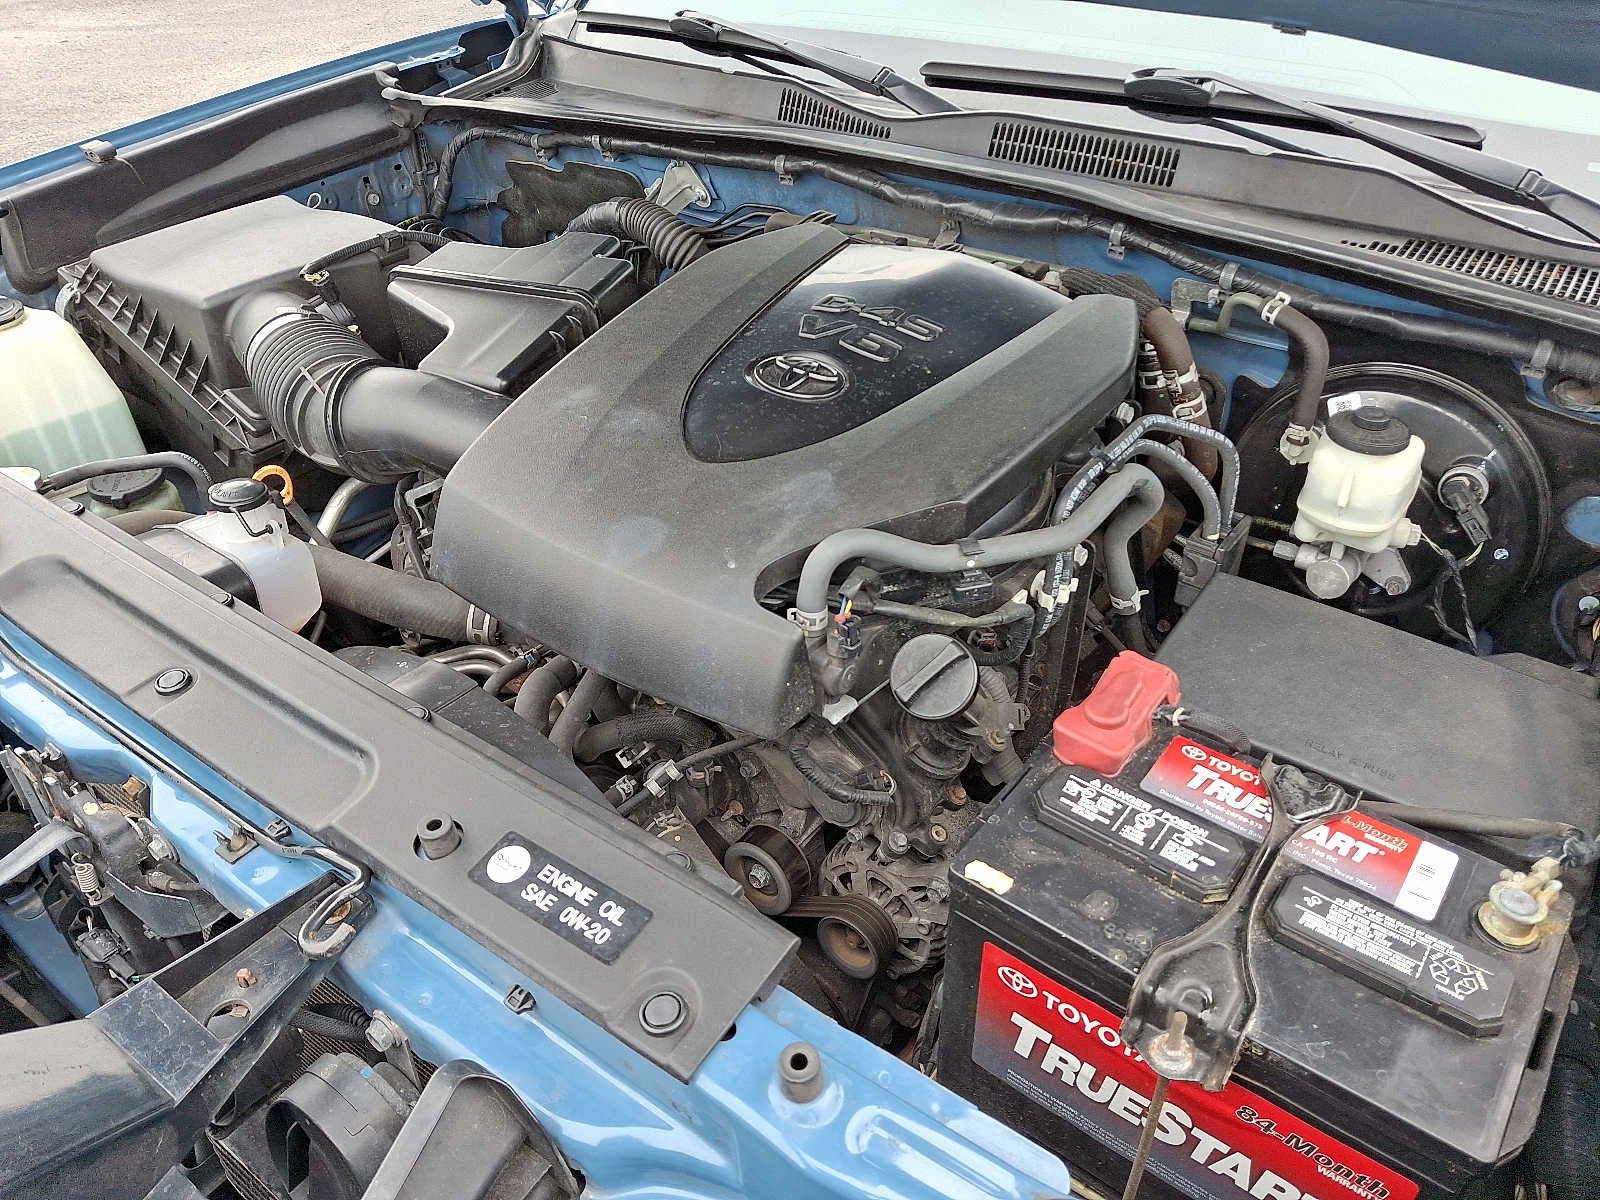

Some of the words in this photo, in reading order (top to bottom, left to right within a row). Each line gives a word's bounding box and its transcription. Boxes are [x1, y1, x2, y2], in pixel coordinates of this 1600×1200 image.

[799, 313, 904, 363] V6
[1208, 755, 1262, 786] TOYOT
[1100, 783, 1152, 811] DANGER
[1160, 810, 1209, 838] POISON
[520, 882, 559, 912] SAE
[559, 906, 611, 945] 0W-20
[536, 863, 598, 907] ENGINE
[598, 900, 627, 927] OIL
[1042, 990, 1145, 1063] TOYO
[1010, 1011, 1319, 1200] TRUESTAR
[1234, 1105, 1391, 1199] 84-Month
